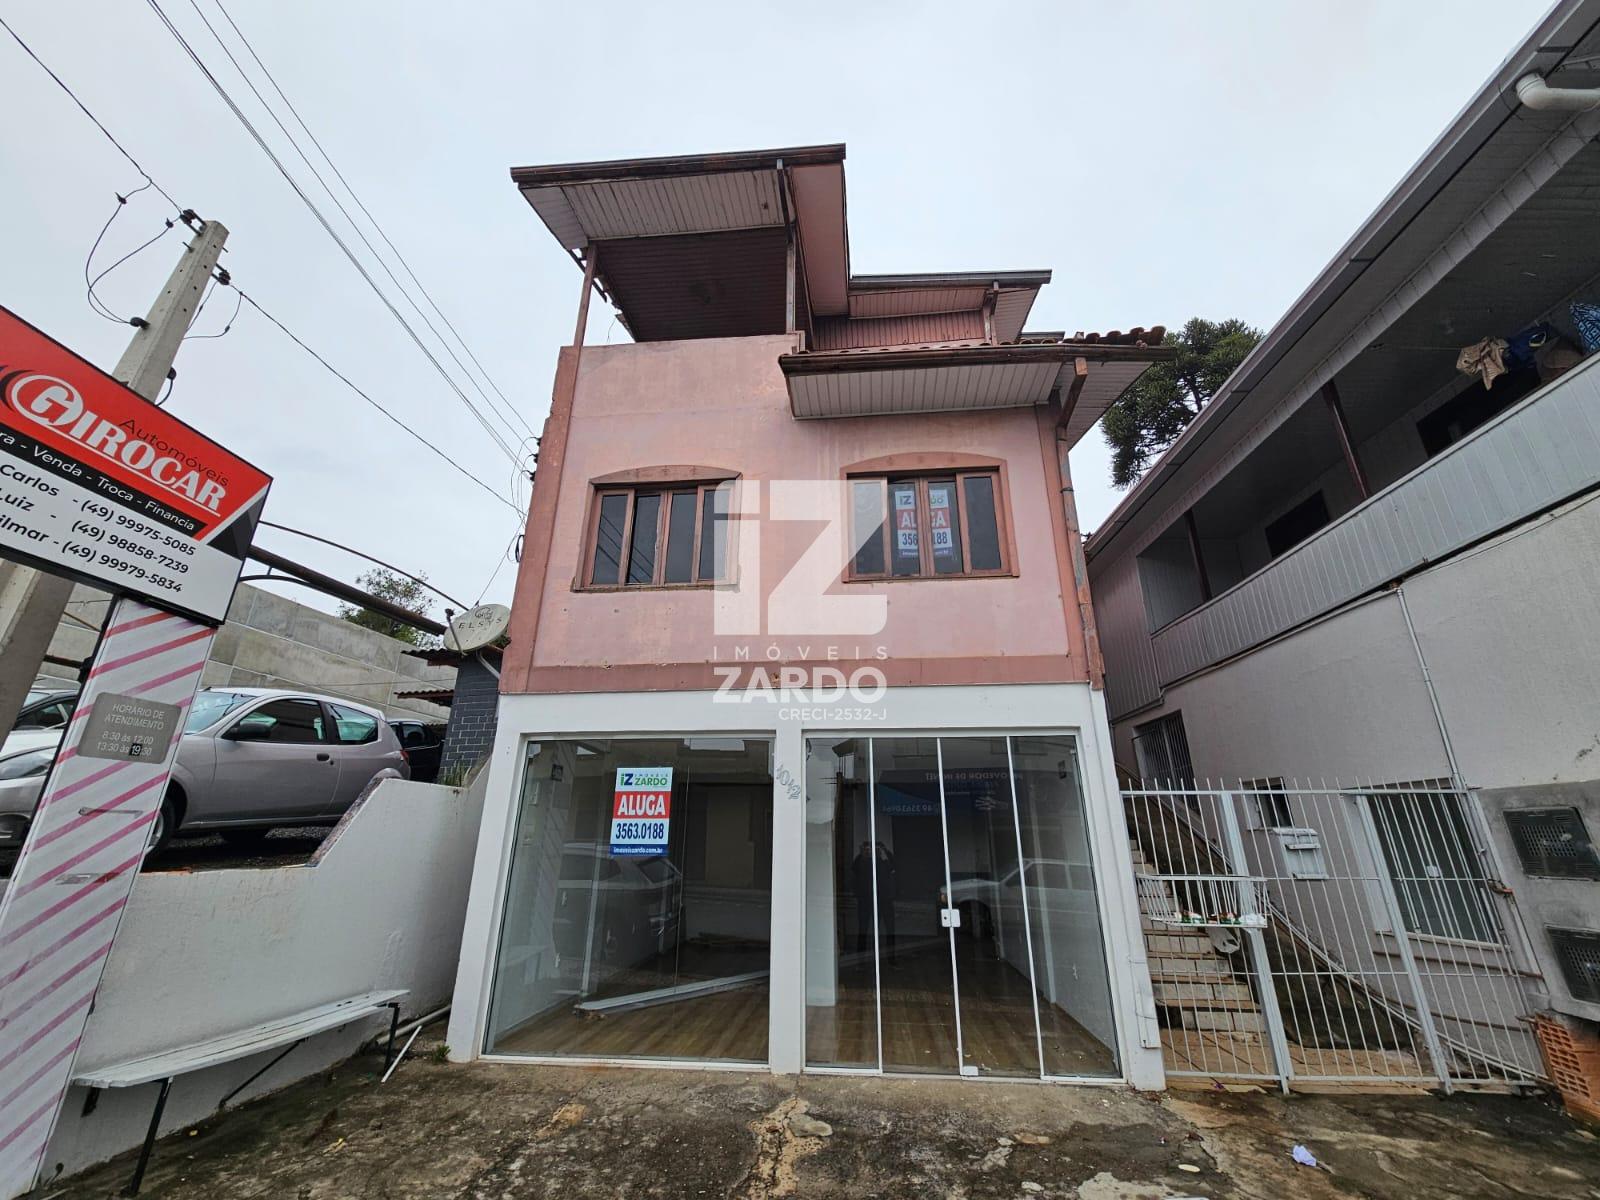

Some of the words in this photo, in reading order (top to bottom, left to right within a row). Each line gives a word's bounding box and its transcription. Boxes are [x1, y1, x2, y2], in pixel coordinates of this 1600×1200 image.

[11, 374, 227, 511] GIROCAR
[119, 418, 229, 487] Automóveis
[0, 464, 59, 496] Carlos
[81, 500, 114, 522] (49)
[117, 514, 197, 556] 99975-5085
[34, 445, 82, 477] Venda
[97, 476, 134, 502] Troca
[145, 500, 195, 531] Financia
[61, 540, 97, 562] (49)
[98, 553, 183, 594] 99979-5834
[72, 520, 106, 542] (49)
[110, 534, 190, 574] 98858-7239
[104, 713, 164, 730] ATENDIMENTO
[152, 710, 165, 720] DE
[617, 794, 666, 816] ALUGA
[634, 777, 668, 786] ZARDO
[615, 822, 665, 840] 3563.0188
